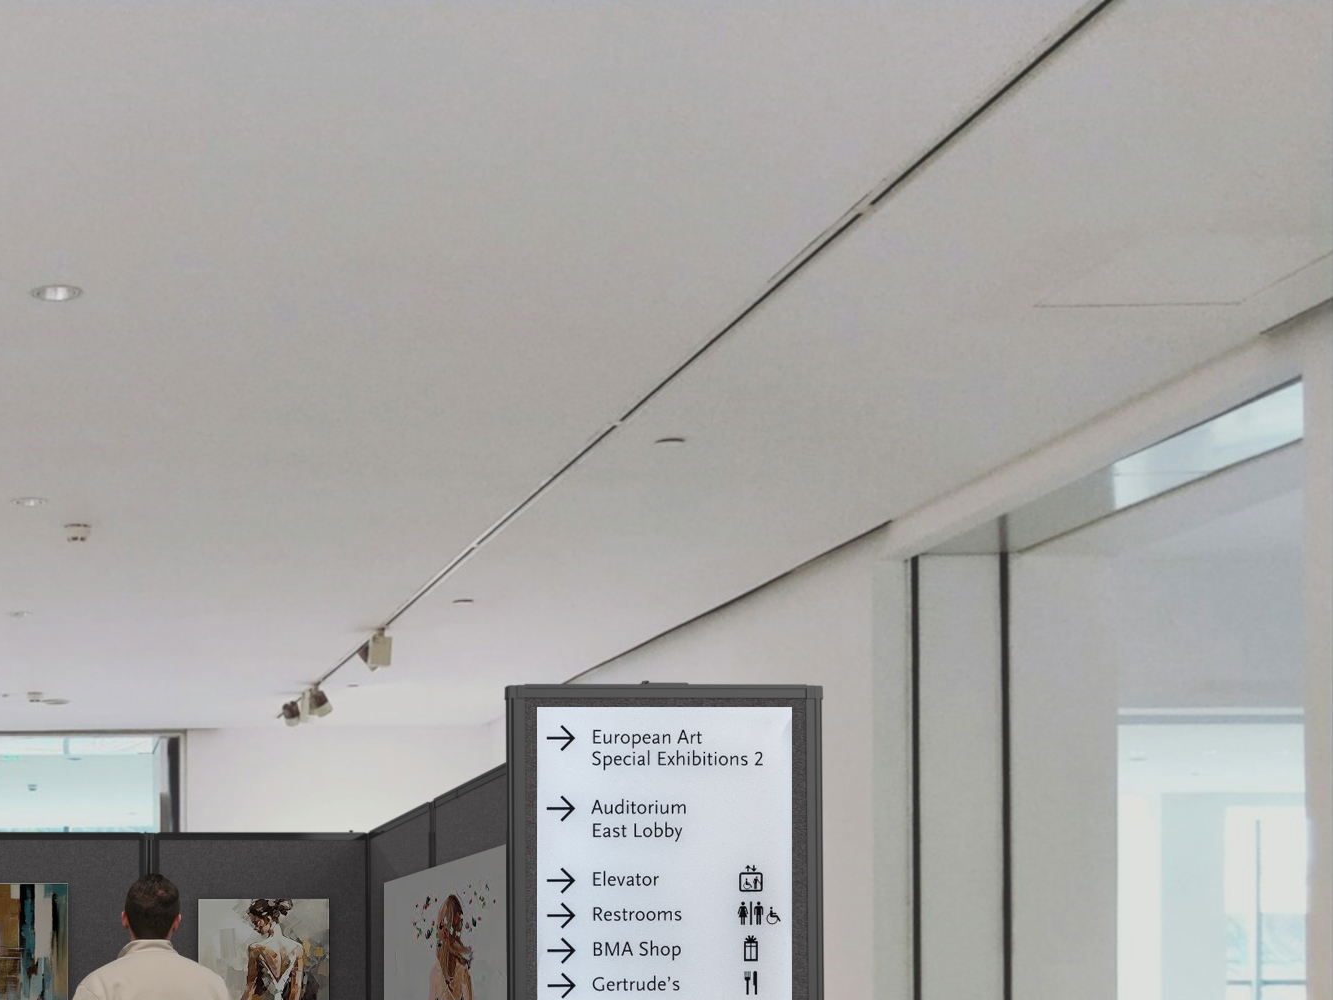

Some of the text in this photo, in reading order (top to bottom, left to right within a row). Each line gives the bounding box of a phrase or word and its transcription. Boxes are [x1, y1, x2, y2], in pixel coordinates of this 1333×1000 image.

[592, 729, 703, 748] European Art
[592, 750, 764, 770] Special Exhibitions 2
[591, 799, 687, 815] Auditorium
[592, 822, 683, 842] East Lobby
[592, 871, 660, 886] Elevator
[592, 907, 682, 922] Restrooms
[593, 940, 682, 961] BMA Shop
[592, 975, 681, 991] Gertrude’s
